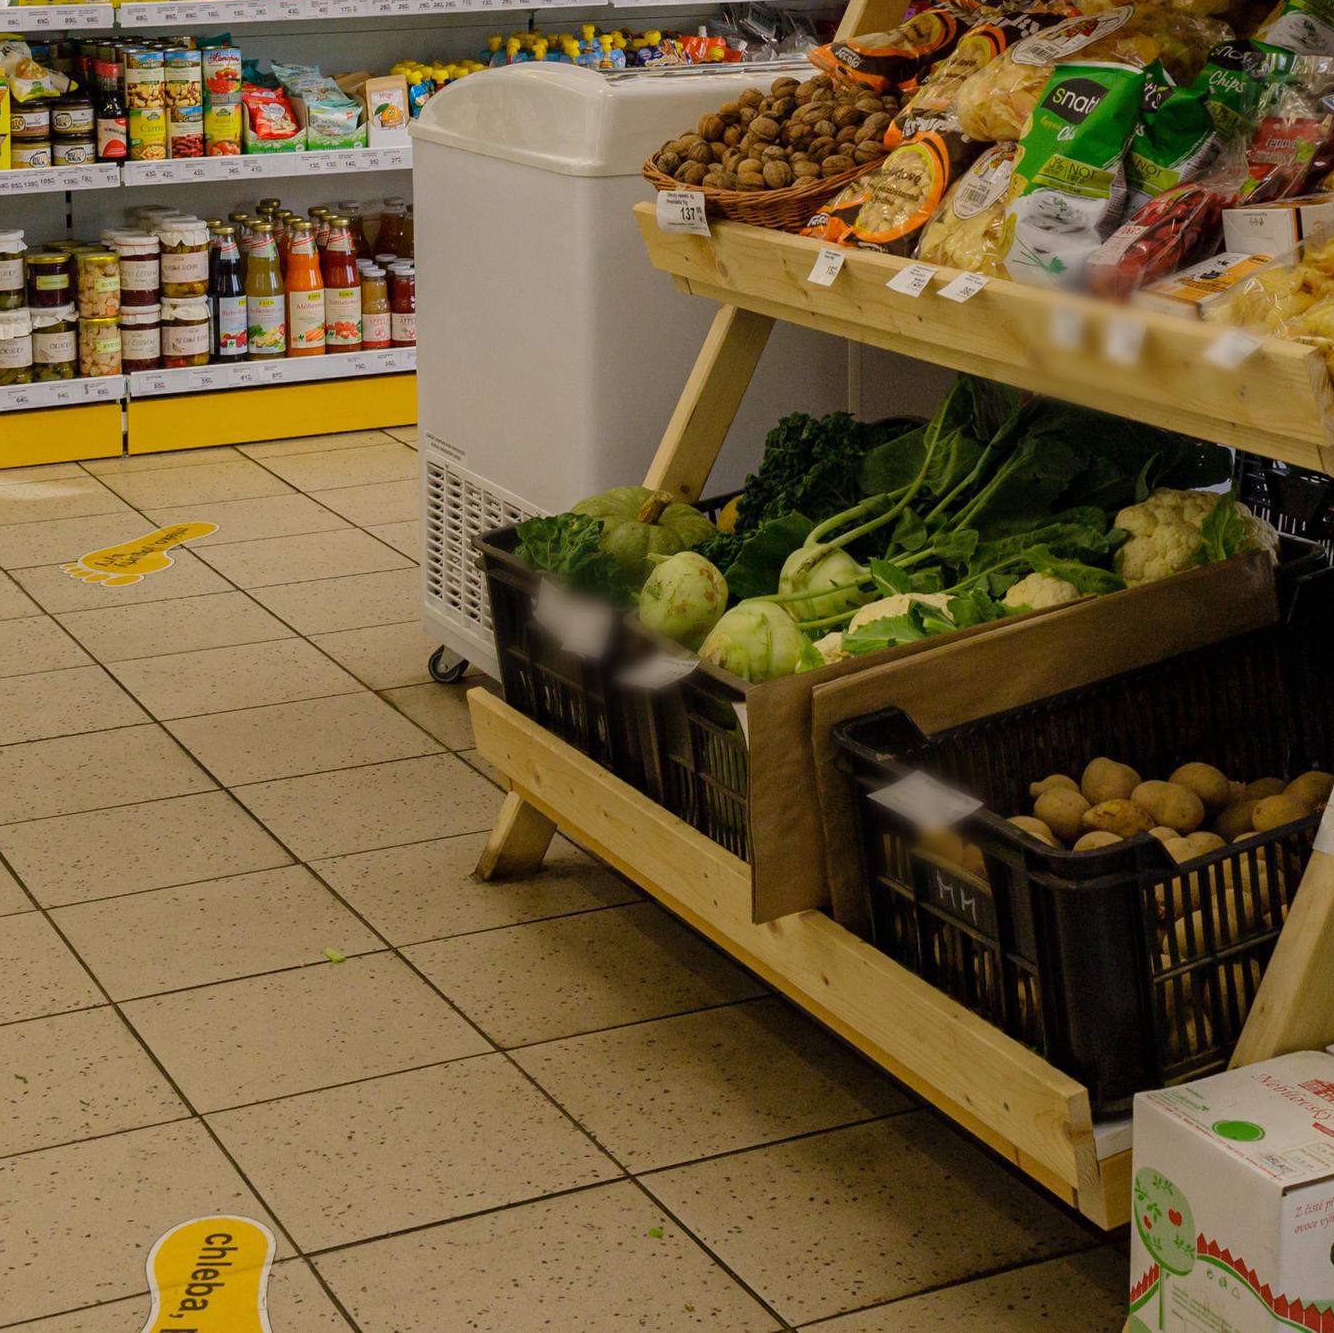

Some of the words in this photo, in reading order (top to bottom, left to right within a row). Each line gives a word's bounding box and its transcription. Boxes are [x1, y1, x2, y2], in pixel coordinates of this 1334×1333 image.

[1208, 70, 1246, 94] Chips
[1069, 163, 1096, 180] NOT
[1135, 159, 1162, 179] NOT
[680, 207, 696, 220] 137
[1295, 1206, 1302, 1218] Z
[1294, 1220, 1317, 1234] ovoce
[169, 1233, 238, 1318] chleba,
